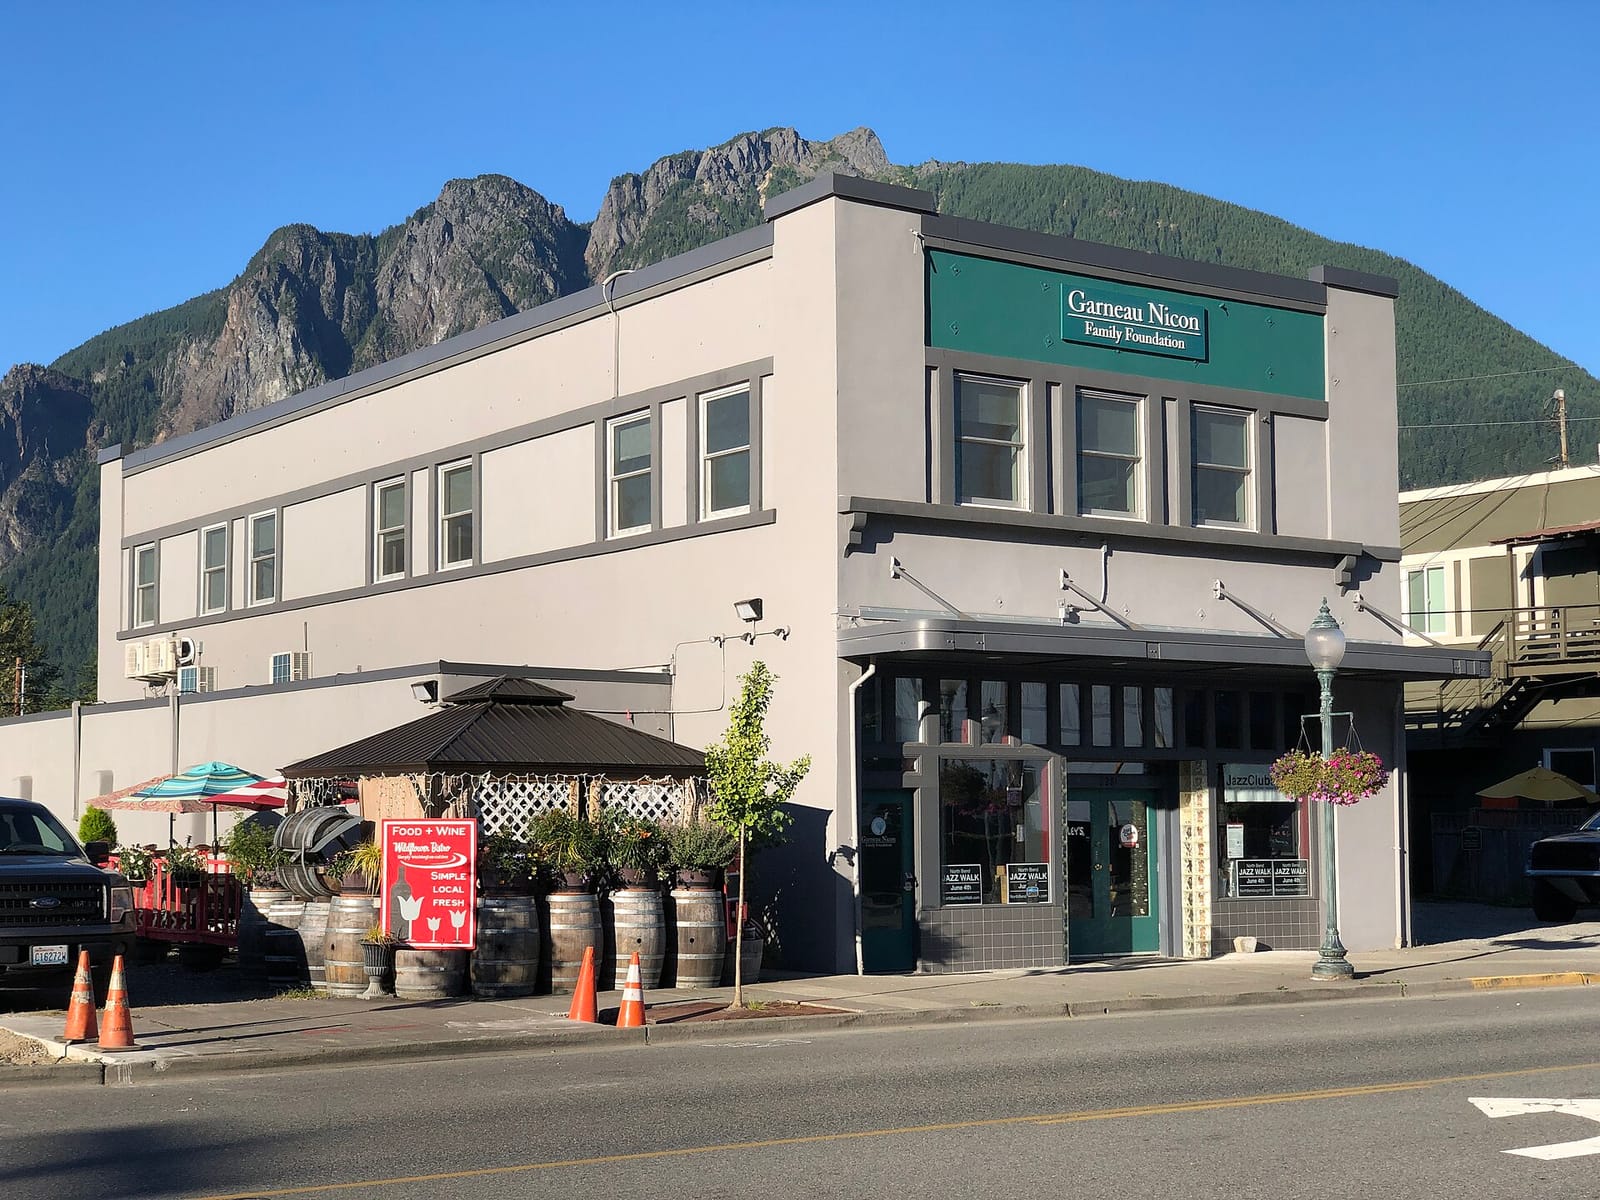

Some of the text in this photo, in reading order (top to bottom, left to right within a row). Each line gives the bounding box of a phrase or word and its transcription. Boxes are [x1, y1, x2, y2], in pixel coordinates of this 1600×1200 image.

[1068, 290, 1200, 331] Garneau Nicon
[1084, 321, 1186, 350] Family Foundation
[392, 826, 422, 836] FOOD
[436, 826, 466, 836] WINE
[430, 871, 467, 881] SIMPLE
[960, 873, 980, 881] WALK
[1010, 872, 1048, 880] JAZZ WALK
[432, 885, 465, 894] LOCAL
[432, 899, 465, 907] FRESH
